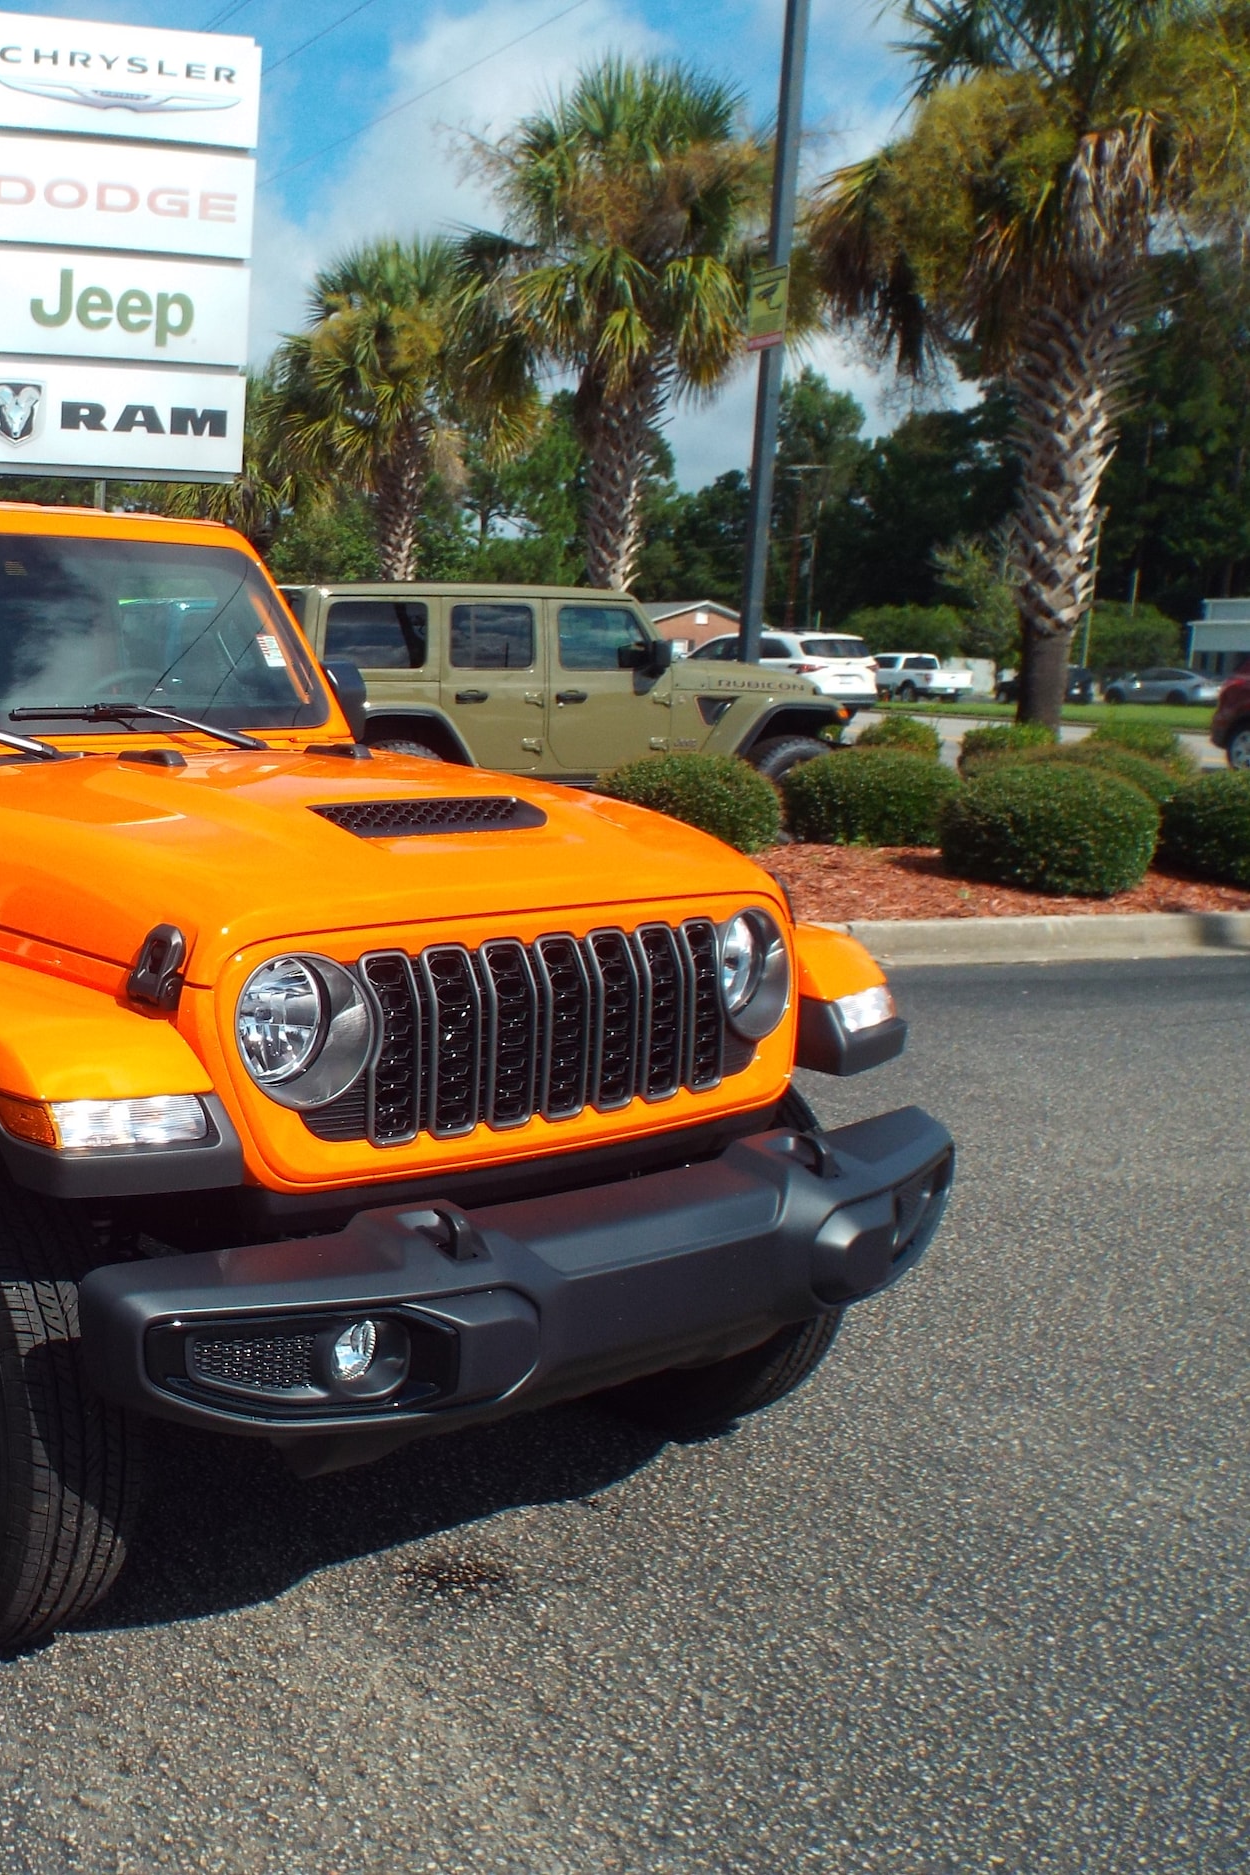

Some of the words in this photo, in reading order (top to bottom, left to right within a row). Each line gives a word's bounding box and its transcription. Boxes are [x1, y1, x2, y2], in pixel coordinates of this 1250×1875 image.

[30, 268, 194, 347] Jeep
[60, 401, 228, 438] RAM
[717, 679, 805, 691] RUBICON
